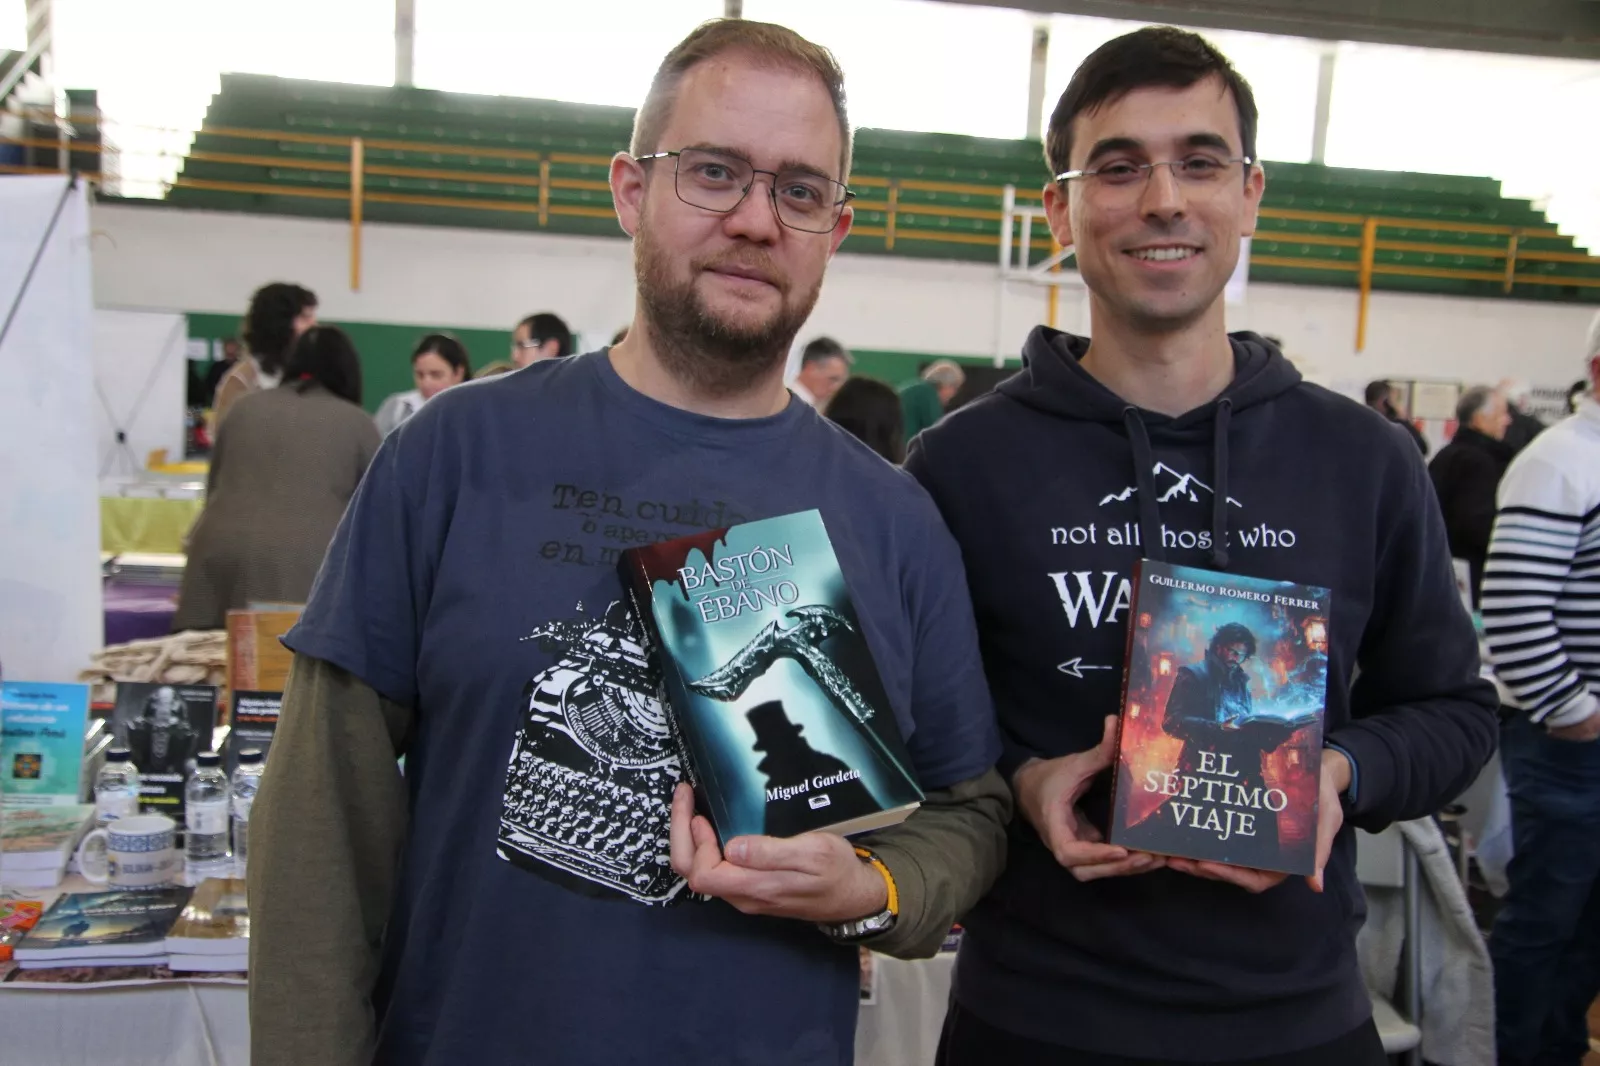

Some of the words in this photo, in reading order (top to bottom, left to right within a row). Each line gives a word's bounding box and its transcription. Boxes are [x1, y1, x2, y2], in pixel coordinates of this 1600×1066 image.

[551, 484, 629, 519] Ten
[540, 540, 588, 564] en
[1050, 523, 1097, 545] not
[1106, 522, 1141, 546] all
[1157, 524, 1231, 549] hos
[1238, 523, 1296, 548] who
[676, 543, 795, 591] BASTÓN
[696, 581, 799, 623] ÉBANO
[730, 579, 752, 592] DE
[1047, 571, 1131, 628] WA
[1149, 574, 1215, 594] GUILLERMO
[1218, 586, 1271, 603] ROMERO
[1273, 595, 1319, 611] FERRER
[1196, 750, 1240, 778] EL
[765, 778, 810, 803] Miguel
[812, 768, 862, 790] Gardeta
[1143, 768, 1288, 812] SÉPTIMO
[1169, 802, 1257, 841] VIAJE
